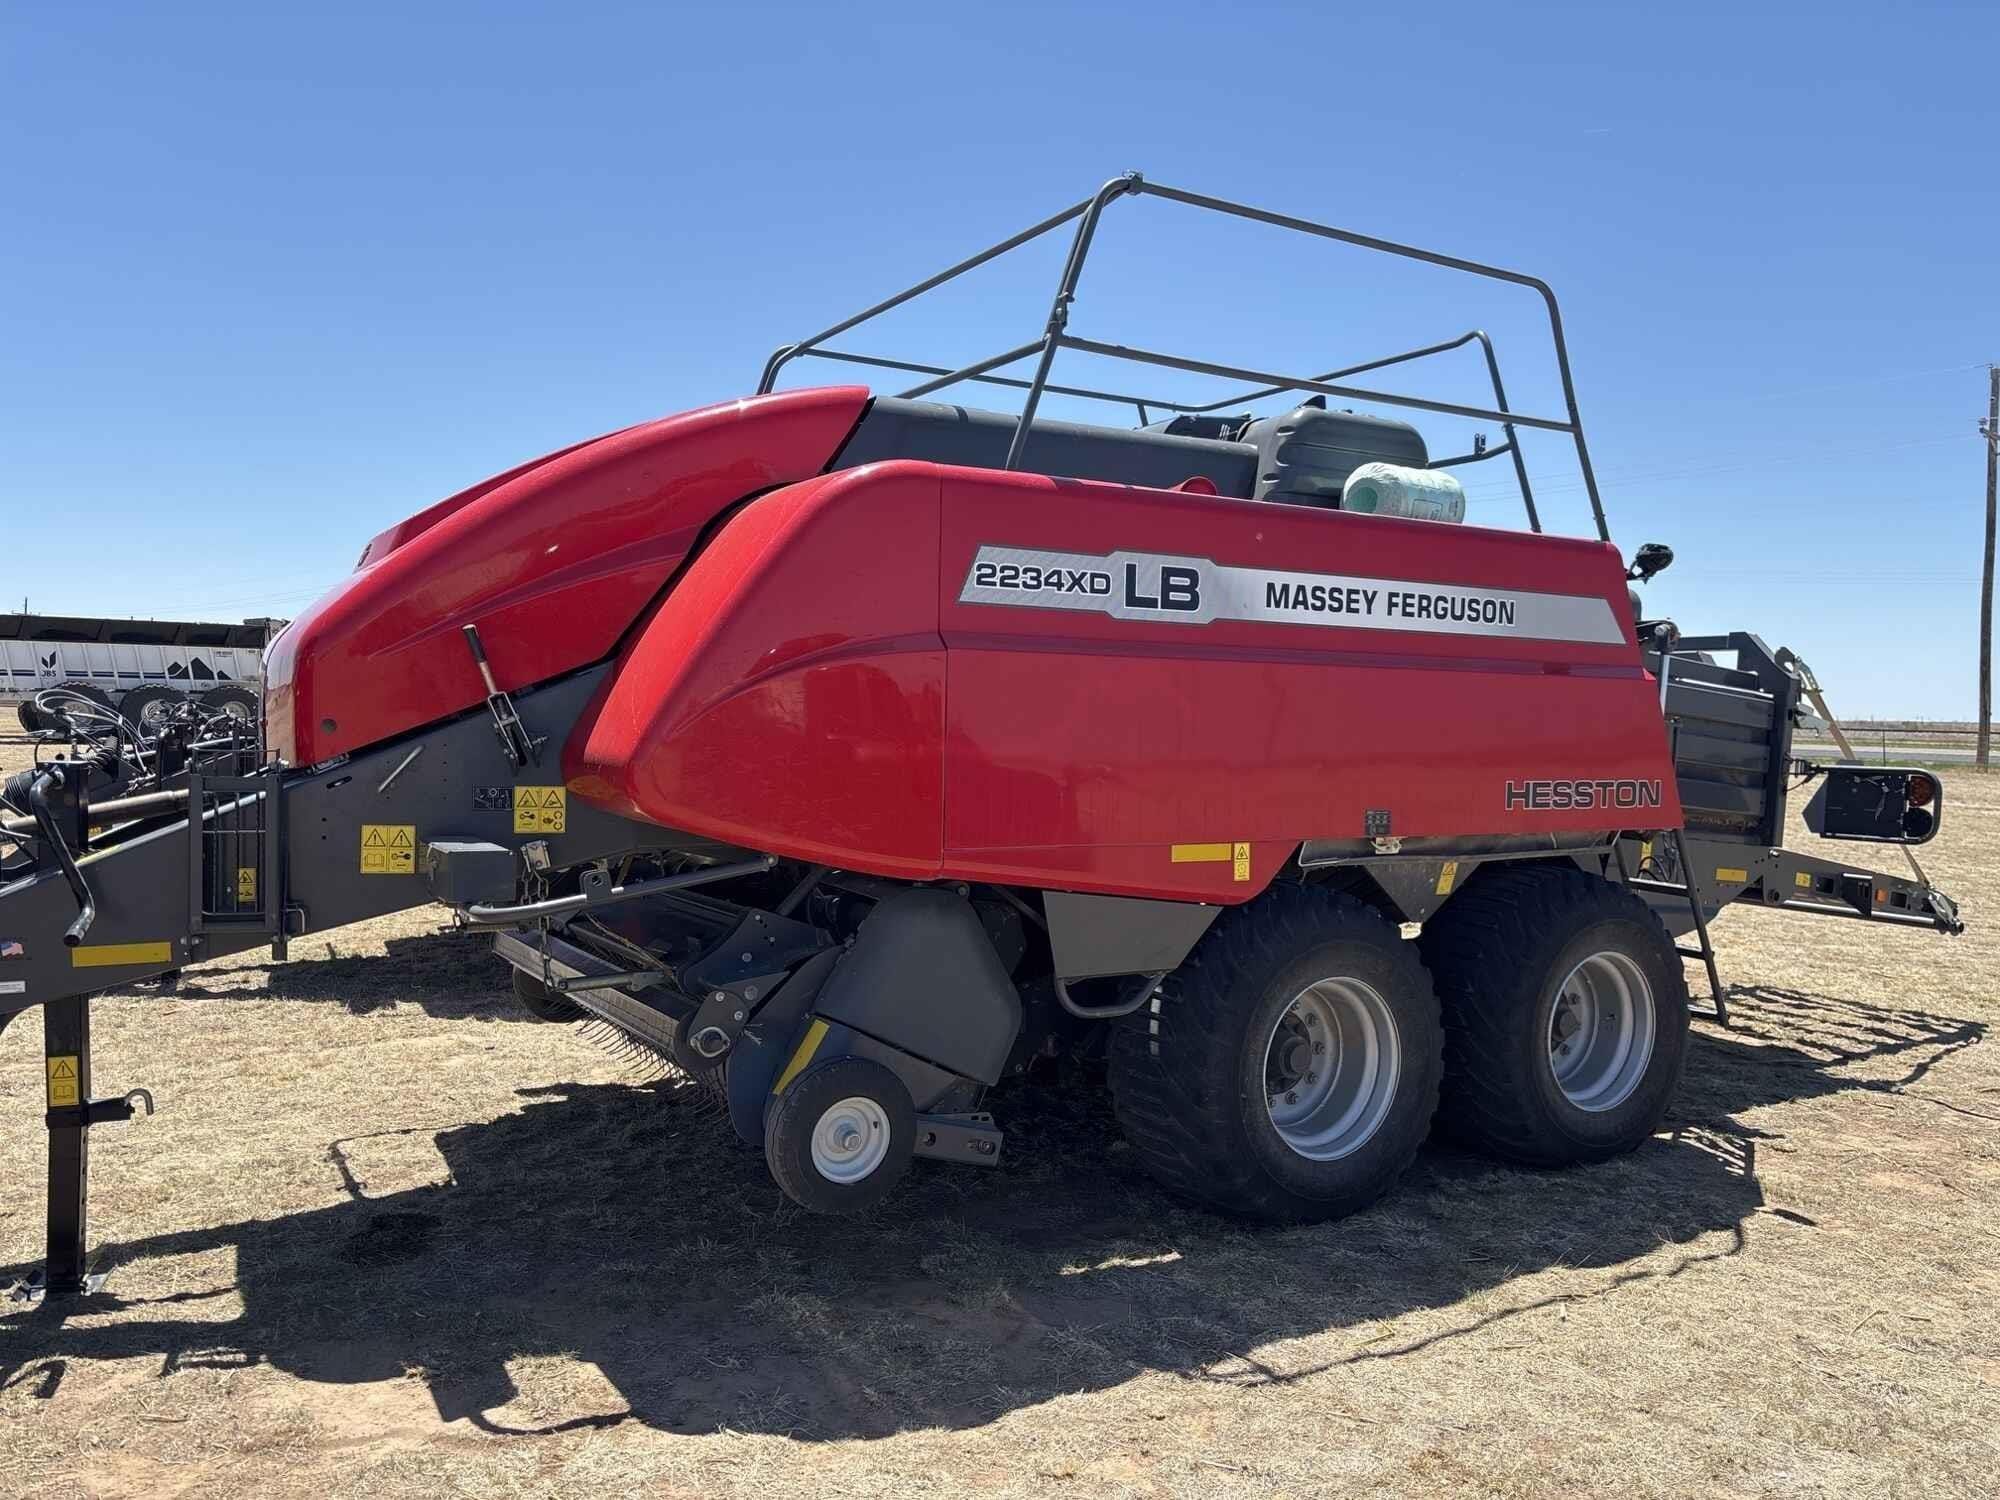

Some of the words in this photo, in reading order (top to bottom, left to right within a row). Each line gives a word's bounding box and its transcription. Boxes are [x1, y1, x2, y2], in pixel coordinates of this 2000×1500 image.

[974, 562, 1112, 596] 2234XD
[1123, 561, 1201, 612] LB
[1264, 581, 1378, 616] MASSEY
[1386, 590, 1516, 626] FERGUSON
[1505, 780, 1662, 810] HESSTON
